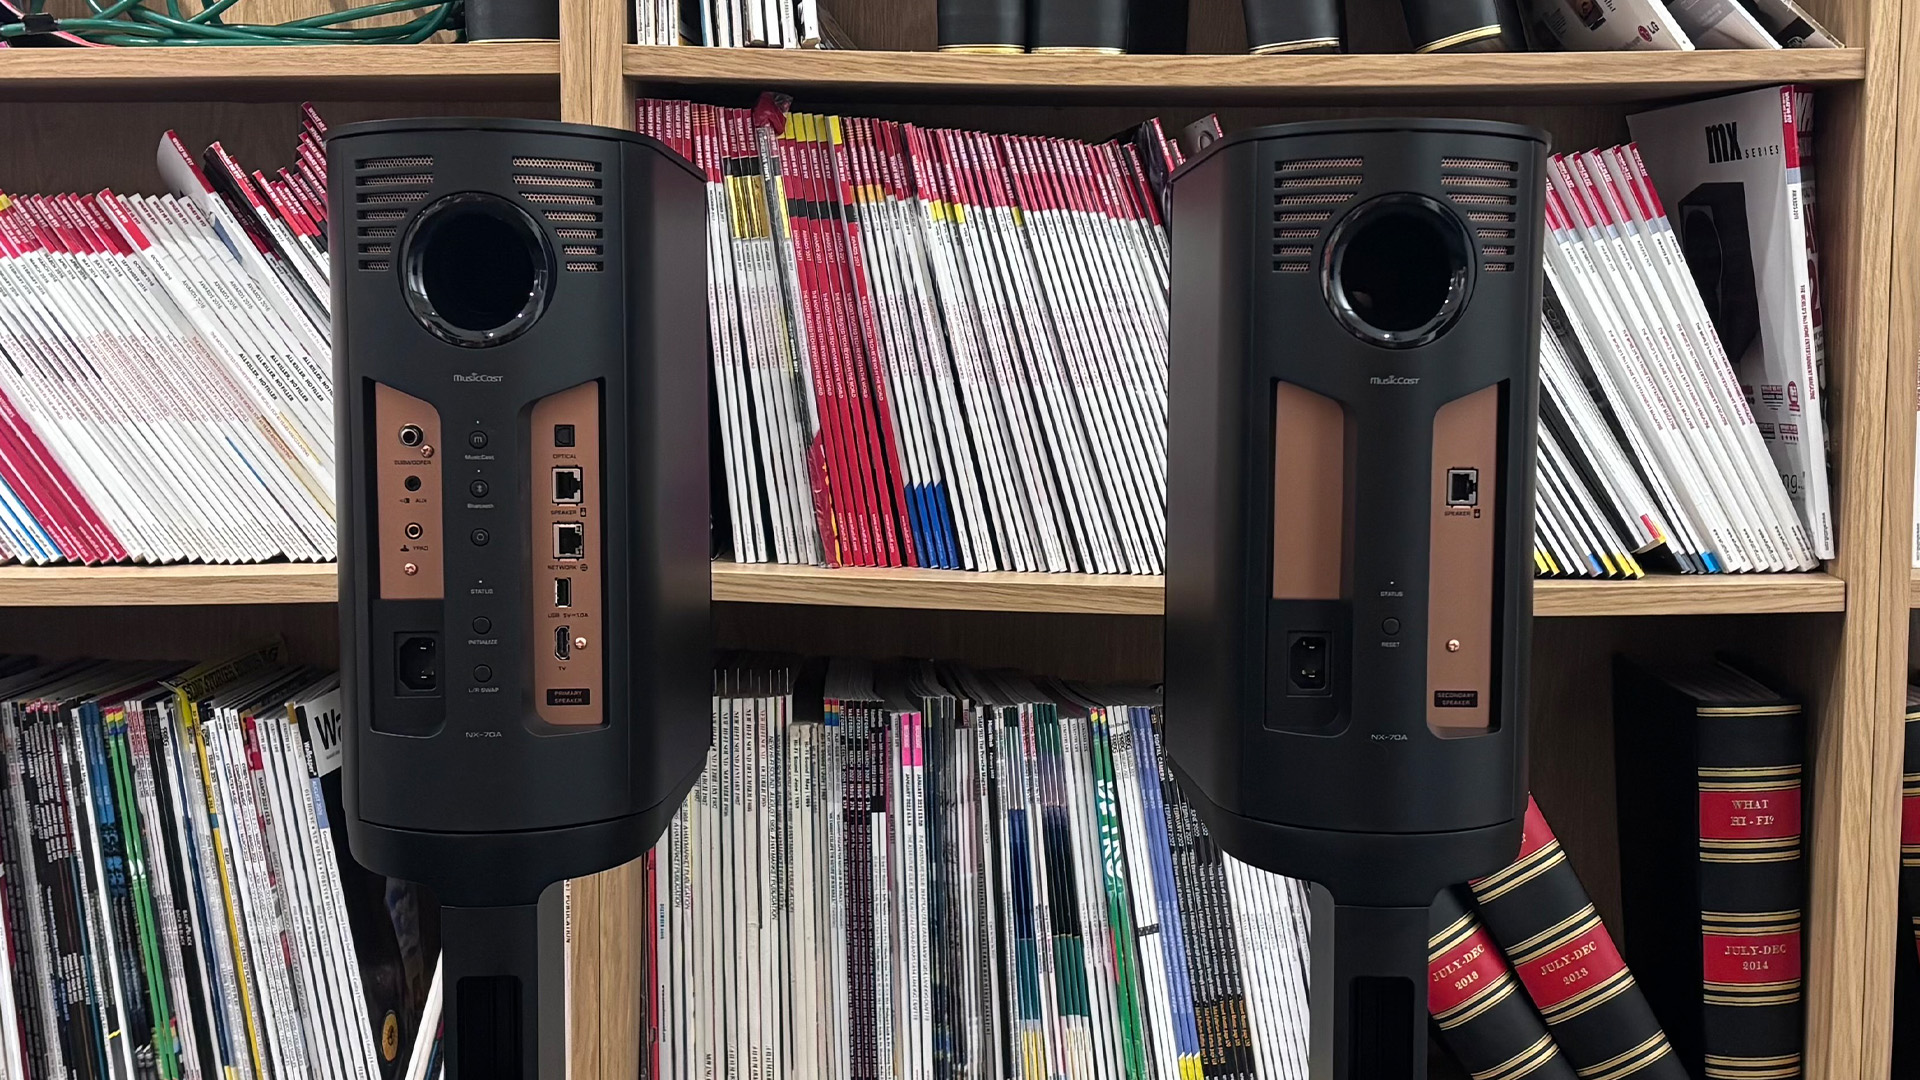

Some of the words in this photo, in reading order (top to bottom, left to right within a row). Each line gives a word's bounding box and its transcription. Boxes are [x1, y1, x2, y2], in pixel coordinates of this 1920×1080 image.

[1649, 21, 1660, 34] LG
[1745, 144, 1780, 160] SERIES
[1803, 338, 1813, 376] ENTERTAINMENT
[238, 352, 247, 362] ALL
[258, 377, 266, 386] NO
[264, 384, 277, 400] FILLER
[255, 353, 264, 363] ALL
[274, 378, 282, 387] NO
[280, 385, 294, 401] FILLER
[270, 353, 279, 363] ALL
[289, 378, 297, 388] NO
[295, 386, 308, 402] FILLER
[285, 353, 294, 363] ALL
[304, 378, 313, 387] NO
[310, 385, 324, 402] FILLER
[453, 373, 503, 383] MusicCast
[1370, 375, 1421, 386] MusicCast
[1807, 376, 1815, 400] MAGAZINE
[465, 731, 502, 739] NX-70A
[1152, 733, 1162, 756] DIGITAL
[1371, 733, 1408, 742] NX-70A
[26, 753, 34, 778] CAMERA
[1156, 756, 1166, 781] CAMERA
[1731, 800, 1769, 810] WHAT
[1432, 943, 1485, 982] JULY-DEC
[1540, 941, 1597, 976] JULY-DEC
[1724, 945, 1787, 957] JULY-DEC
[1742, 961, 1769, 972] 2014
